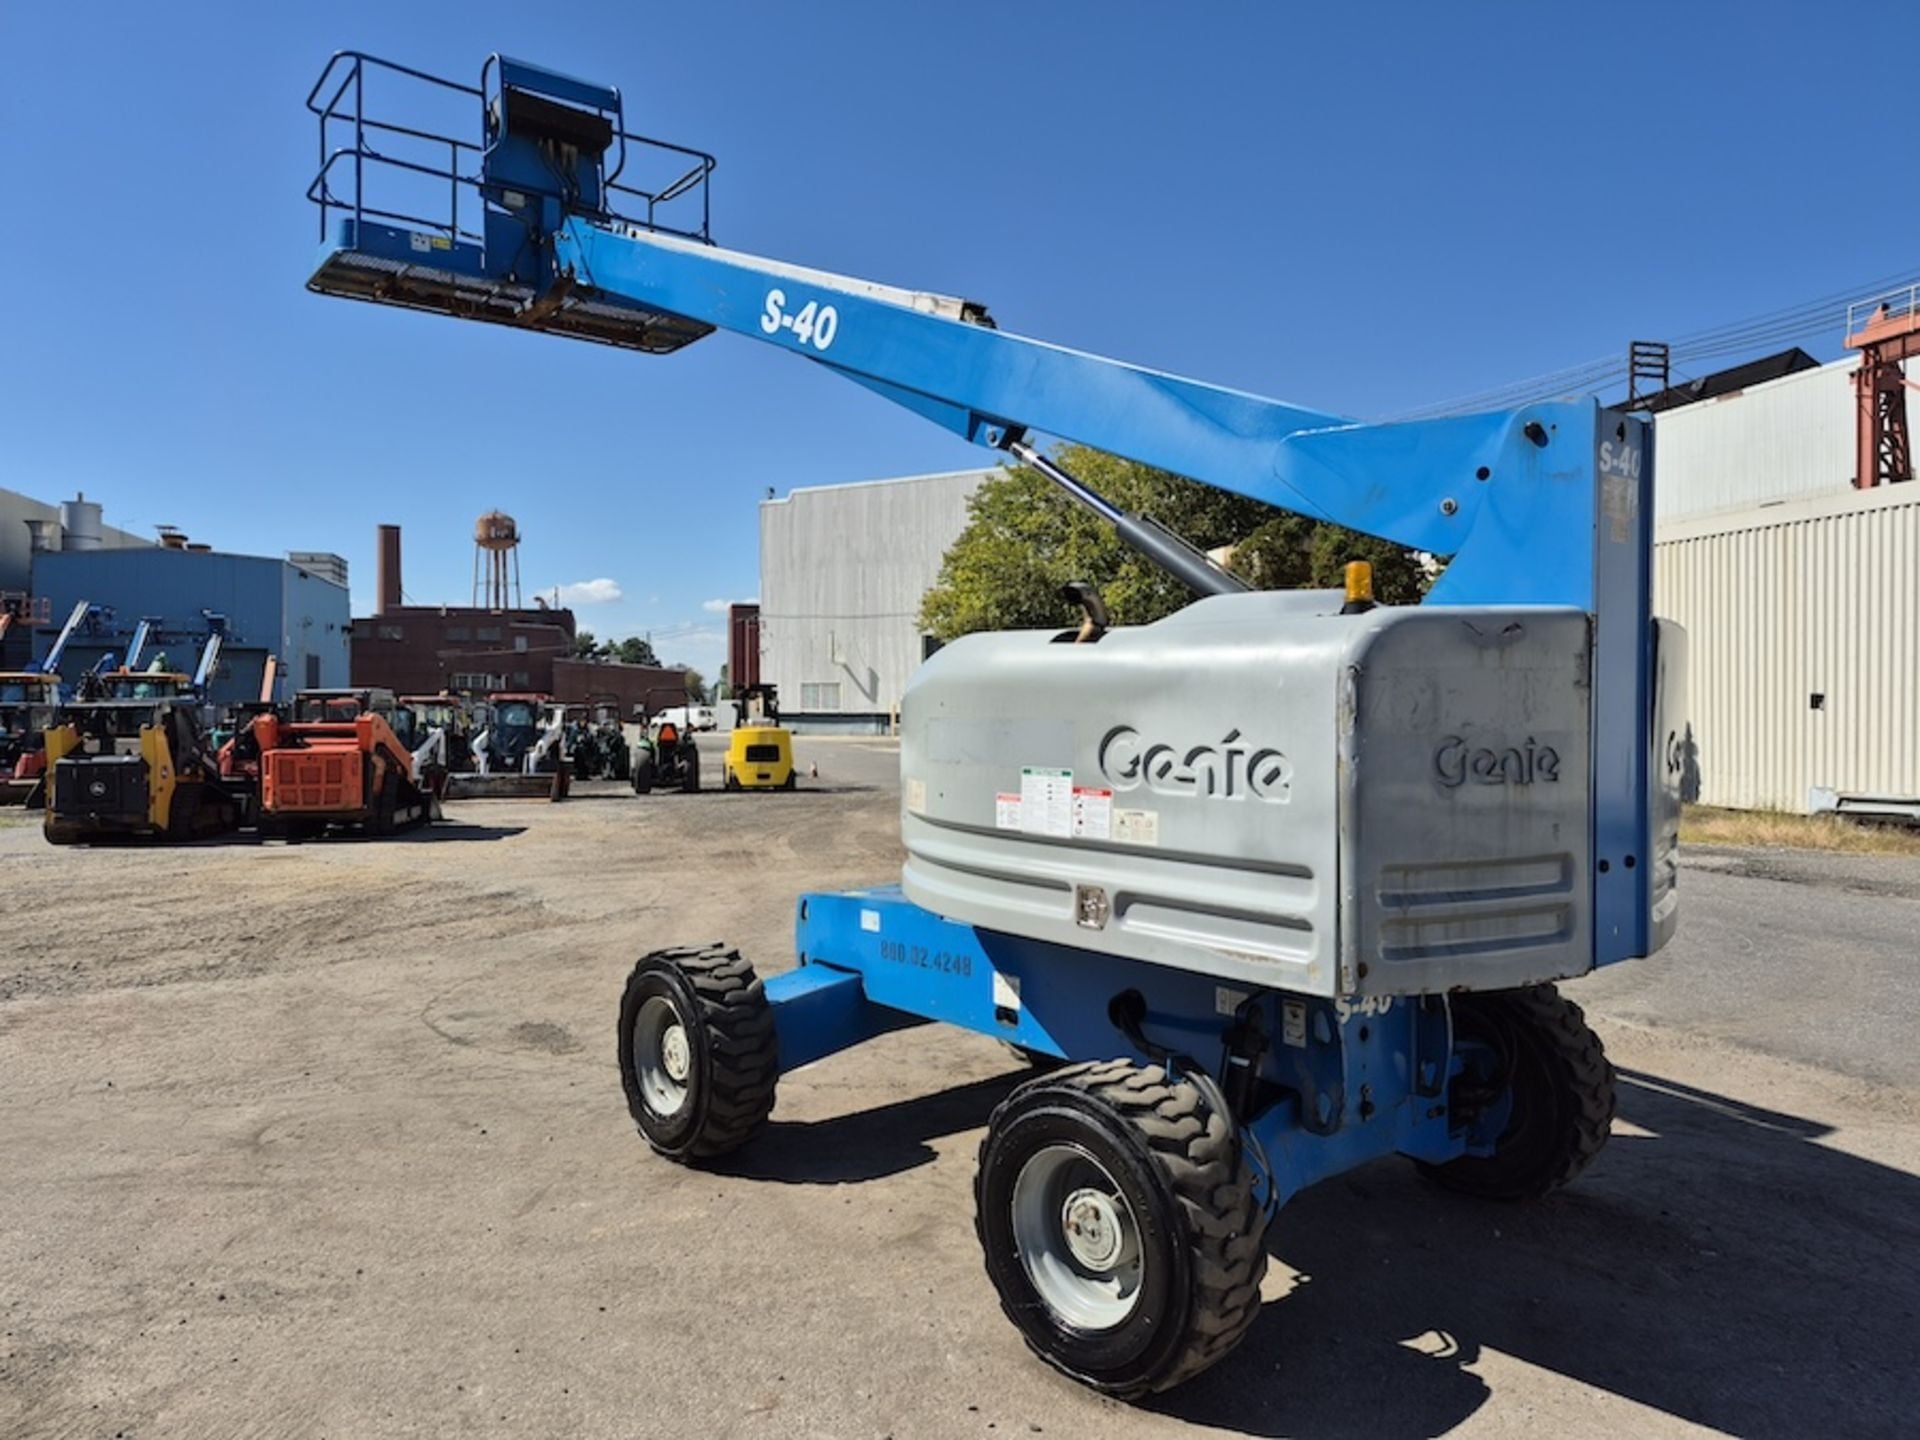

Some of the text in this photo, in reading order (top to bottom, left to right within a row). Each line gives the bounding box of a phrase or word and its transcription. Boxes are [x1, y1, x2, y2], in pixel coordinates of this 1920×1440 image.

[760, 288, 838, 351] S-40
[1098, 725, 1294, 804] Genie
[1435, 735, 1561, 788] Genie
